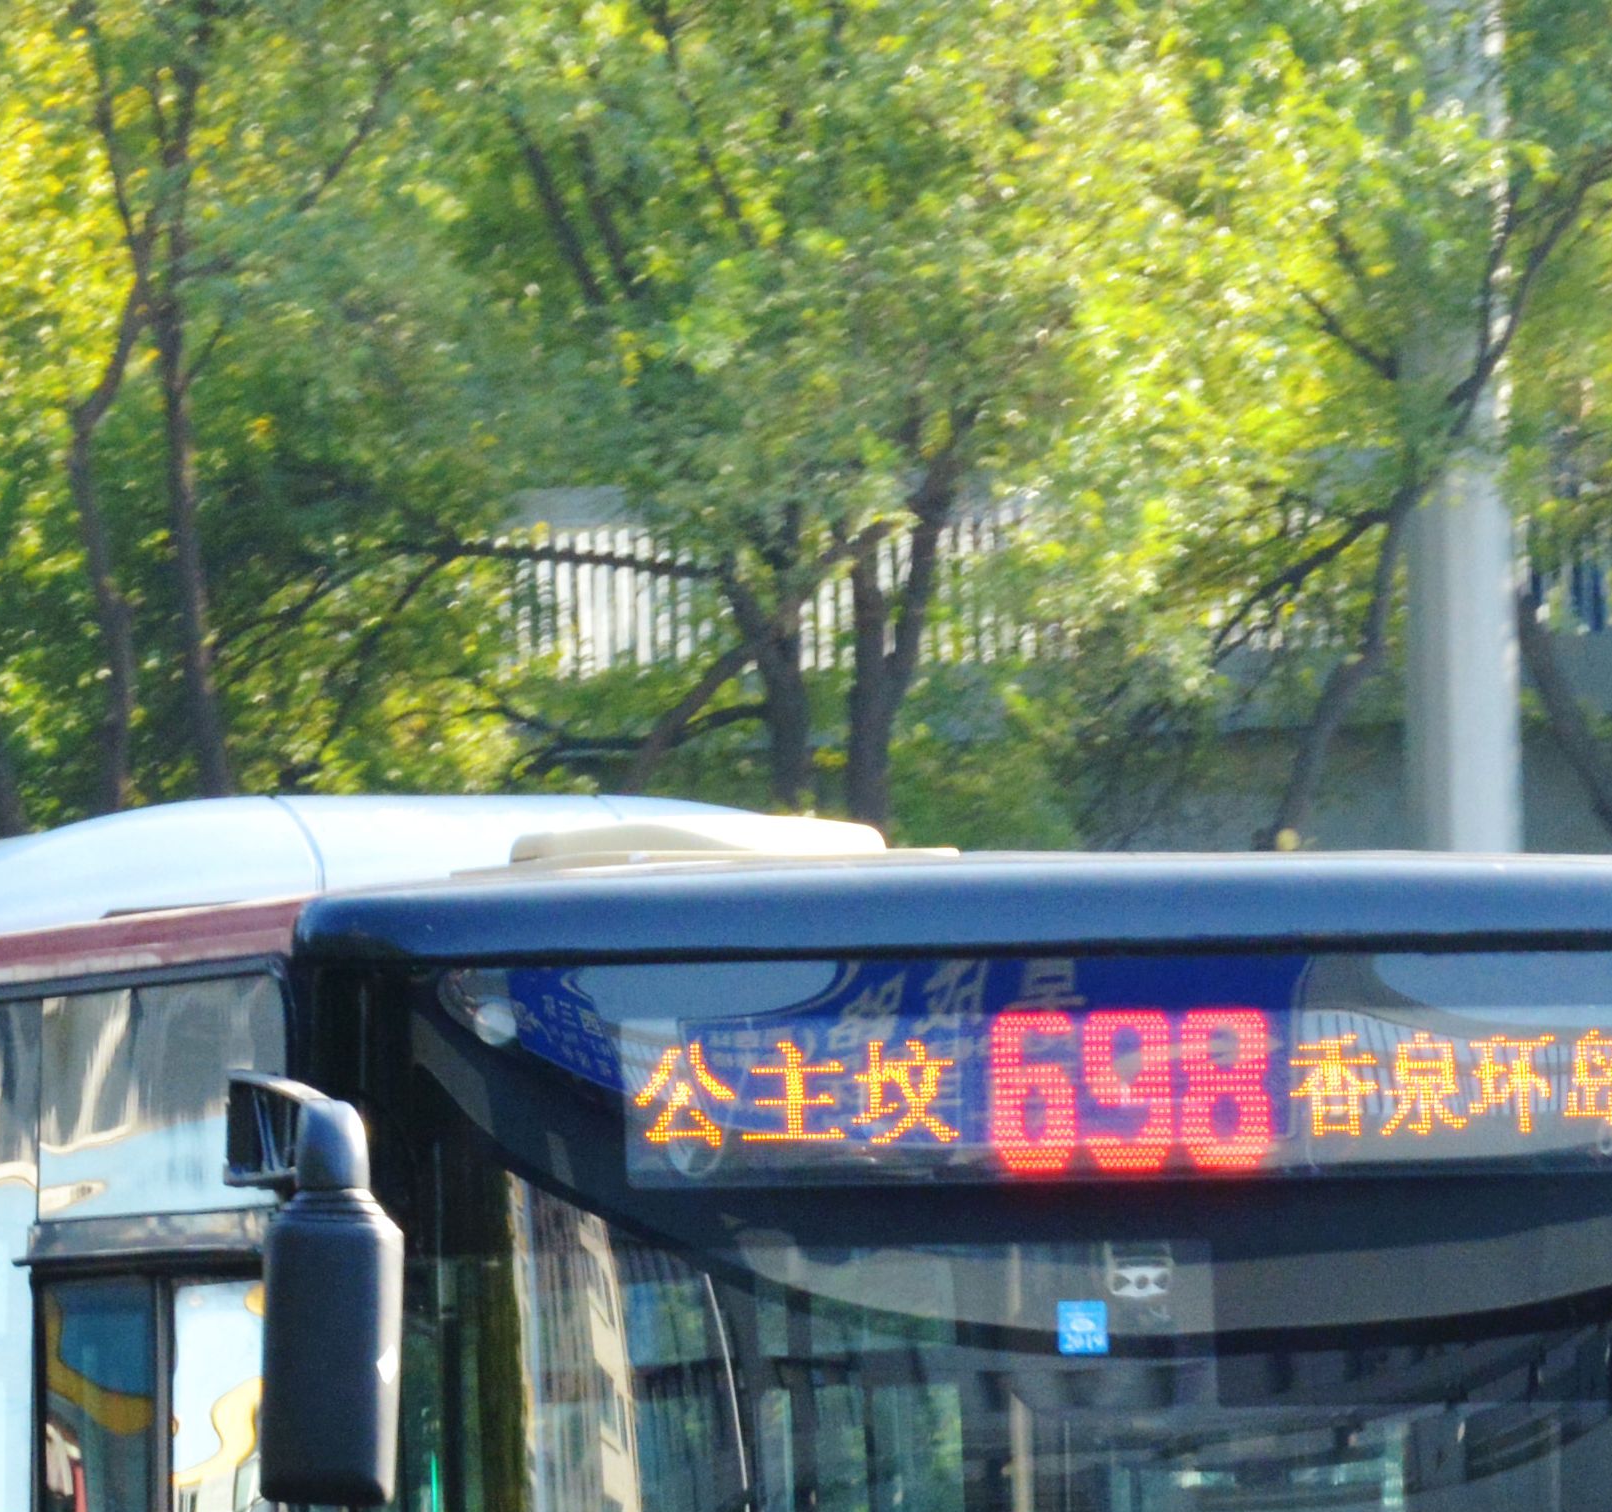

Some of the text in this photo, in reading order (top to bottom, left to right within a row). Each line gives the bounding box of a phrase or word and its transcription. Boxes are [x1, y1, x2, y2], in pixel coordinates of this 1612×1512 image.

[634, 1039, 960, 1145] 公主坟
[992, 1009, 1270, 1172] 698
